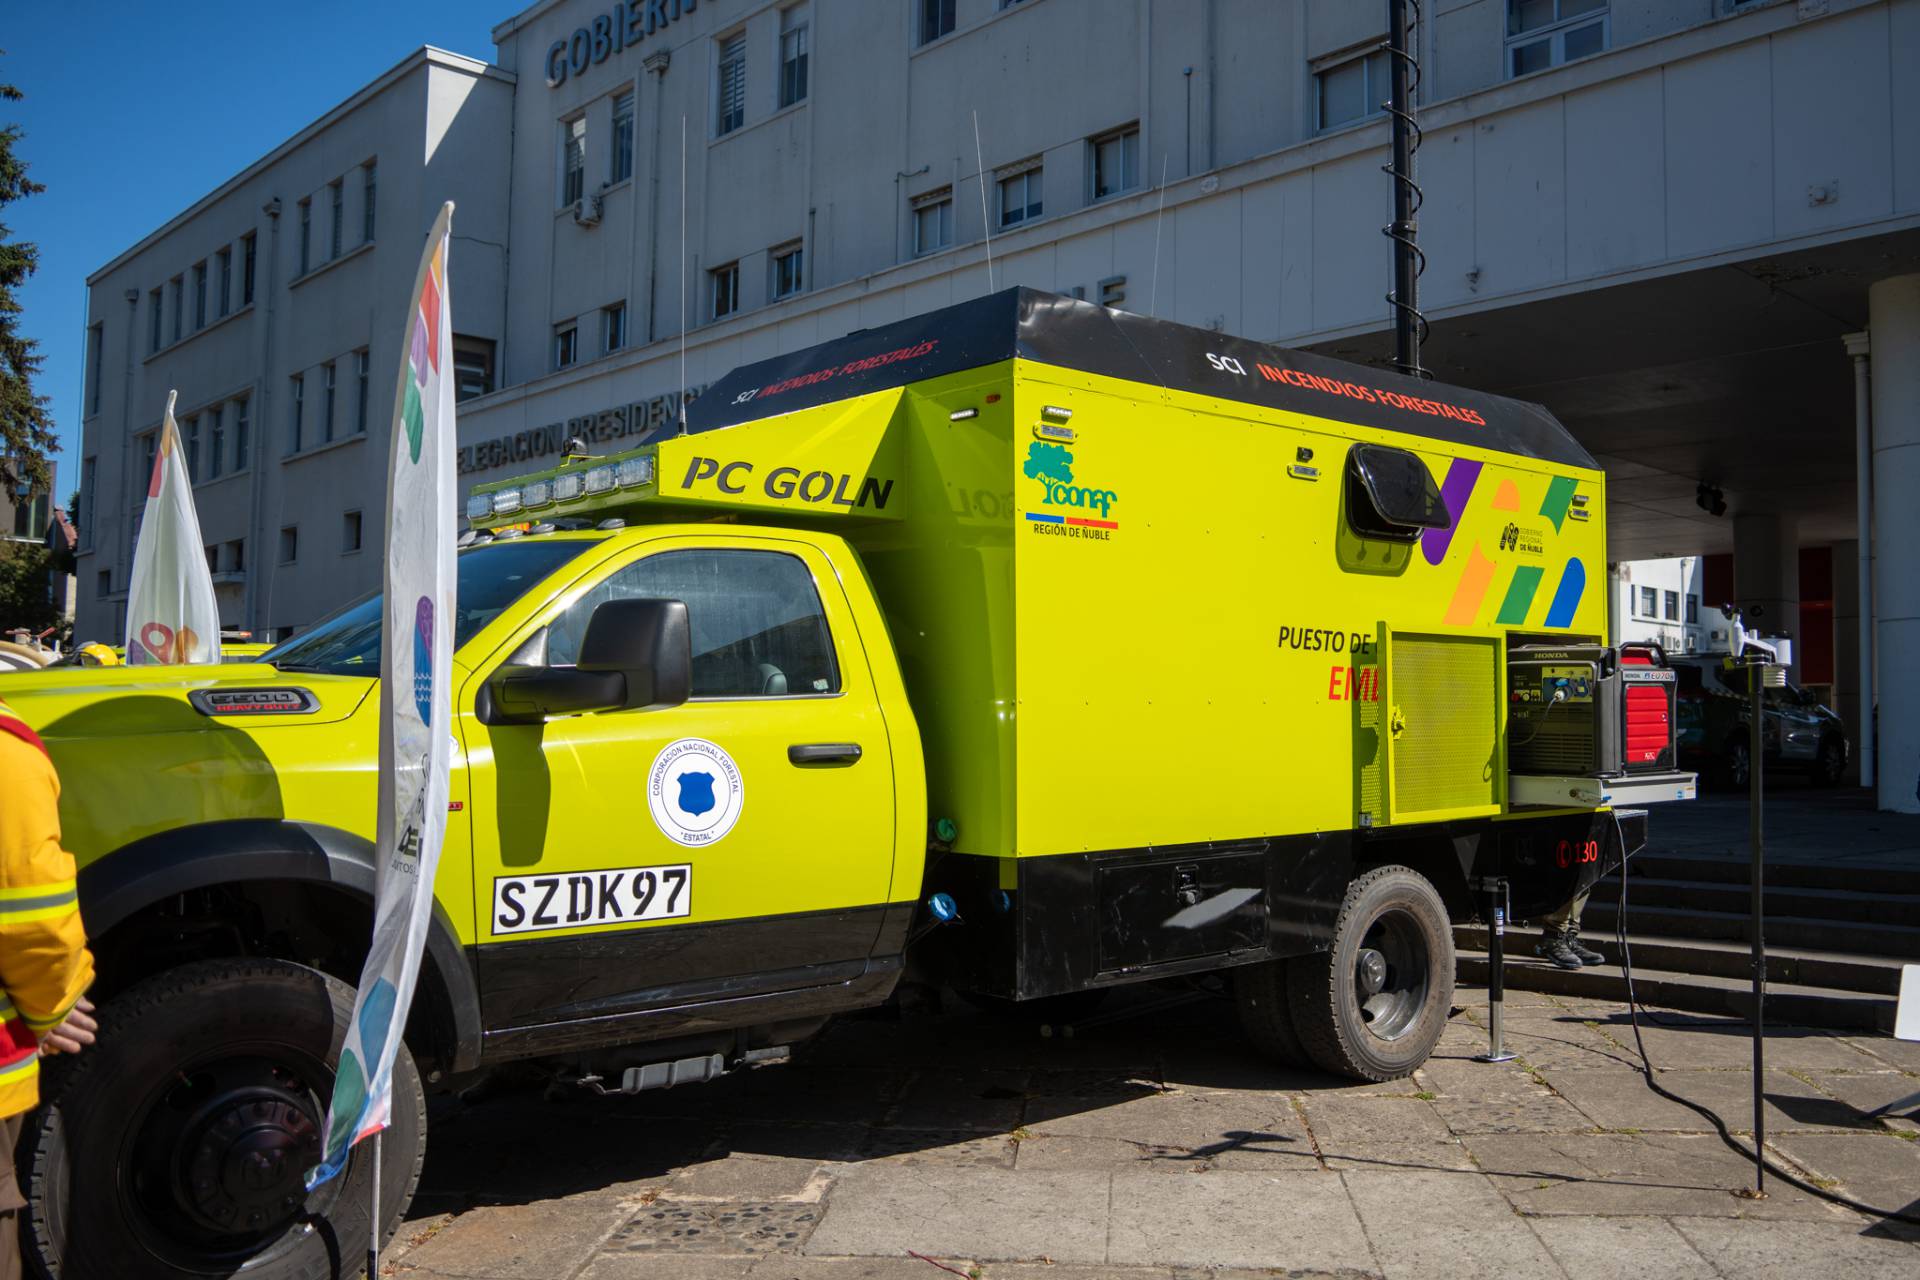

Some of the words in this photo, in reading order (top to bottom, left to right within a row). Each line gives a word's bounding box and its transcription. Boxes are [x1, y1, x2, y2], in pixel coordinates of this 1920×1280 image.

[544, 0, 706, 89] GOBIER
[731, 388, 759, 405] SCI
[756, 366, 839, 399] INCENDIOS
[837, 339, 939, 376] FORESTALES
[1205, 352, 1247, 376] SCI
[1256, 363, 1376, 403] INCENDIOS
[1373, 389, 1486, 426] FORESTALES
[456, 422, 564, 475] ELEGACION
[681, 456, 754, 494] PC
[763, 467, 894, 509] GOLN
[1033, 523, 1067, 537] REGIÓN
[1069, 527, 1080, 538] DE
[1082, 526, 1111, 541] ÑUBLE
[1278, 626, 1345, 653] PUESTO
[1350, 633, 1371, 654] DE
[215, 703, 262, 712] HEAVY
[653, 746, 683, 797] CORPORACION
[683, 743, 718, 759] NACIONAL
[719, 755, 739, 795] FORESTAL
[683, 832, 712, 842] ESTATAL
[1575, 840, 1598, 863] 130
[498, 868, 687, 929] SZDK97
